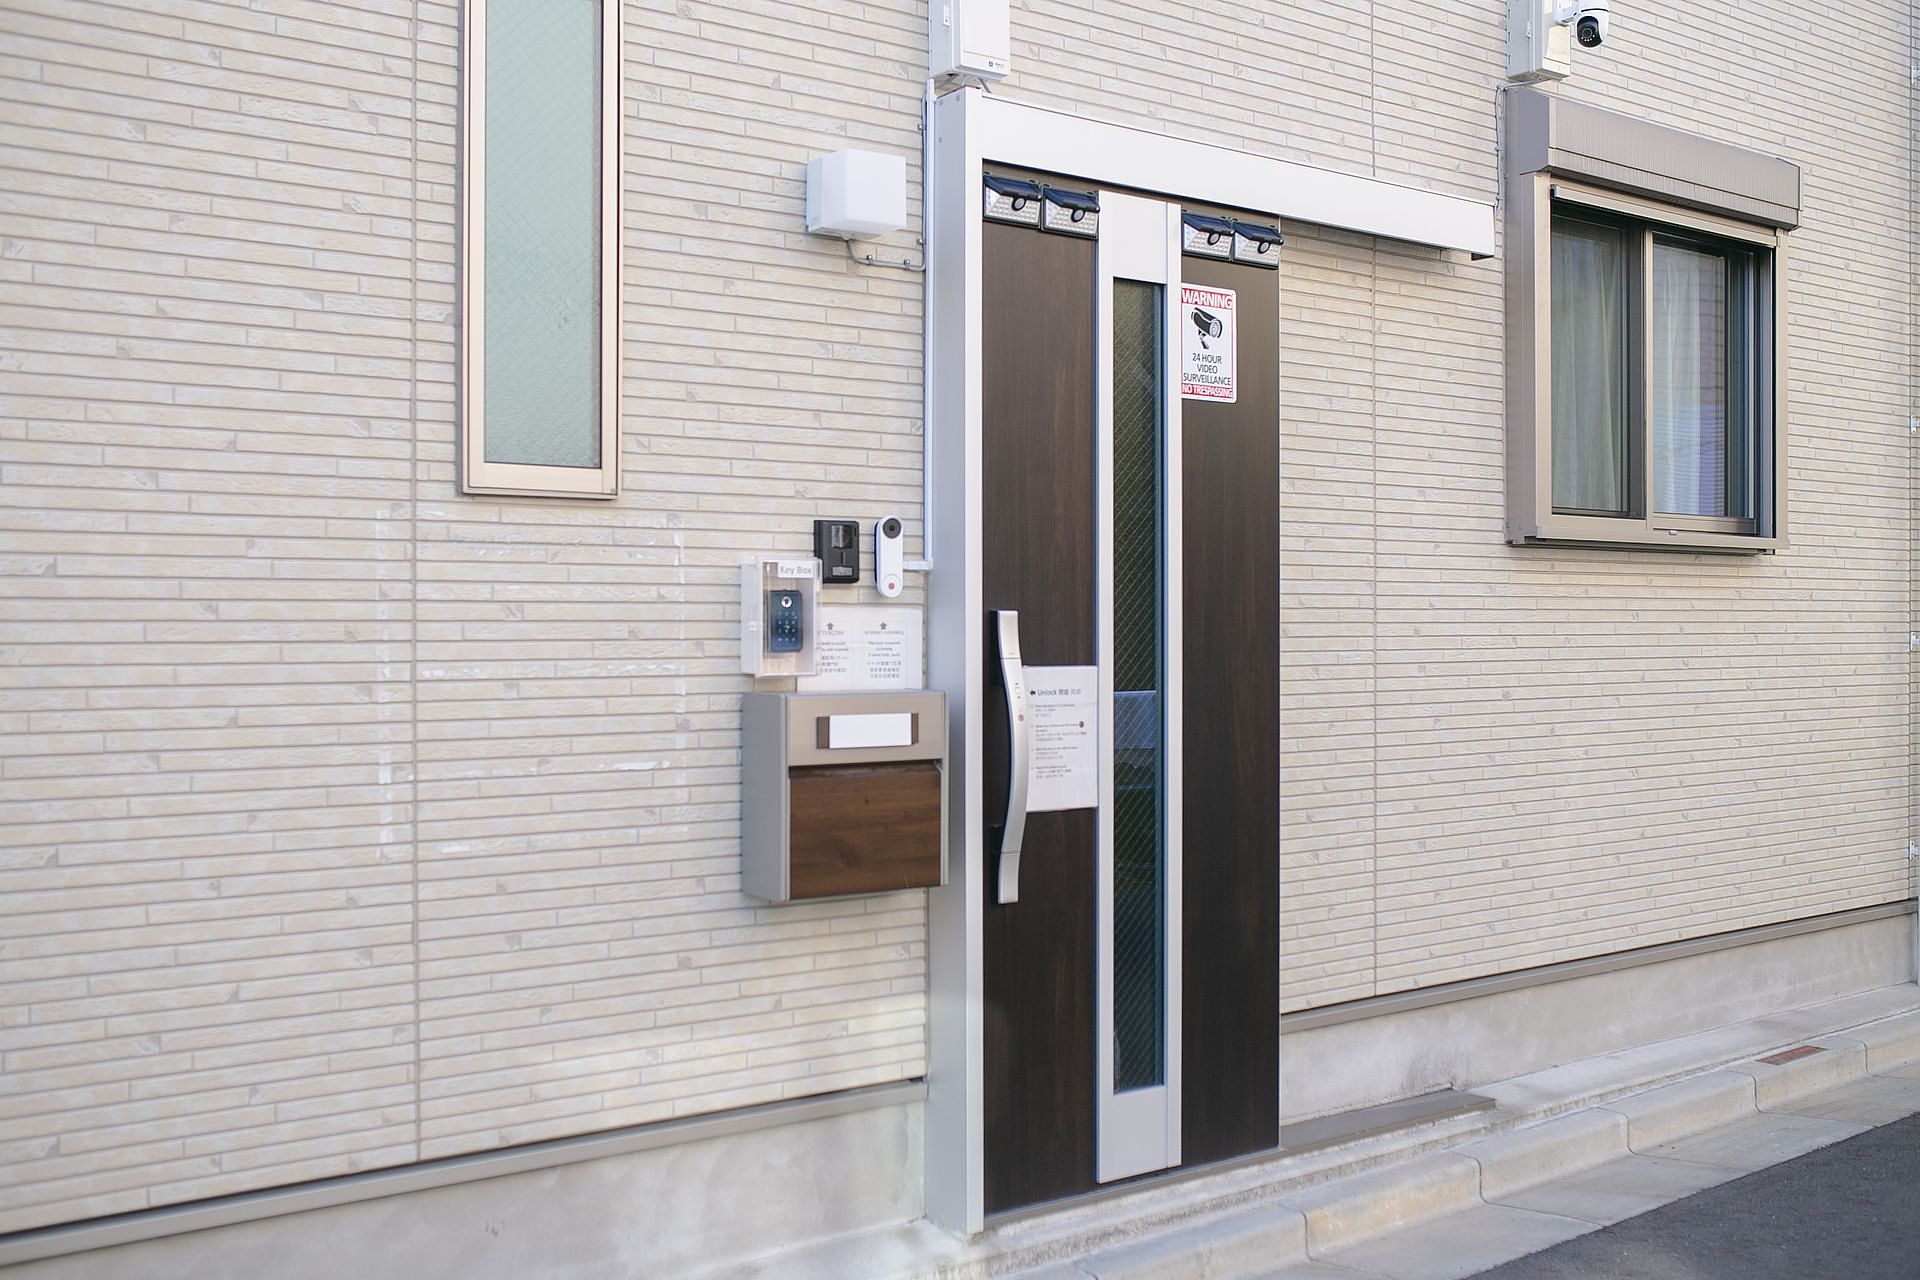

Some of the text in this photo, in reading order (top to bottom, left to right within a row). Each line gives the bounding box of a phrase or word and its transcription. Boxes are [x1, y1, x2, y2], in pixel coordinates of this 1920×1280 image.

[1182, 288, 1232, 309] WARNING
[1192, 352, 1222, 364] 24 HOUR
[1197, 363, 1218, 374] VIDEO
[1183, 372, 1231, 386] SURVEILLANCE
[1182, 384, 1233, 398] NO TRESPASSING
[780, 566, 812, 576] Key Box
[1037, 688, 1057, 696] Unlock
